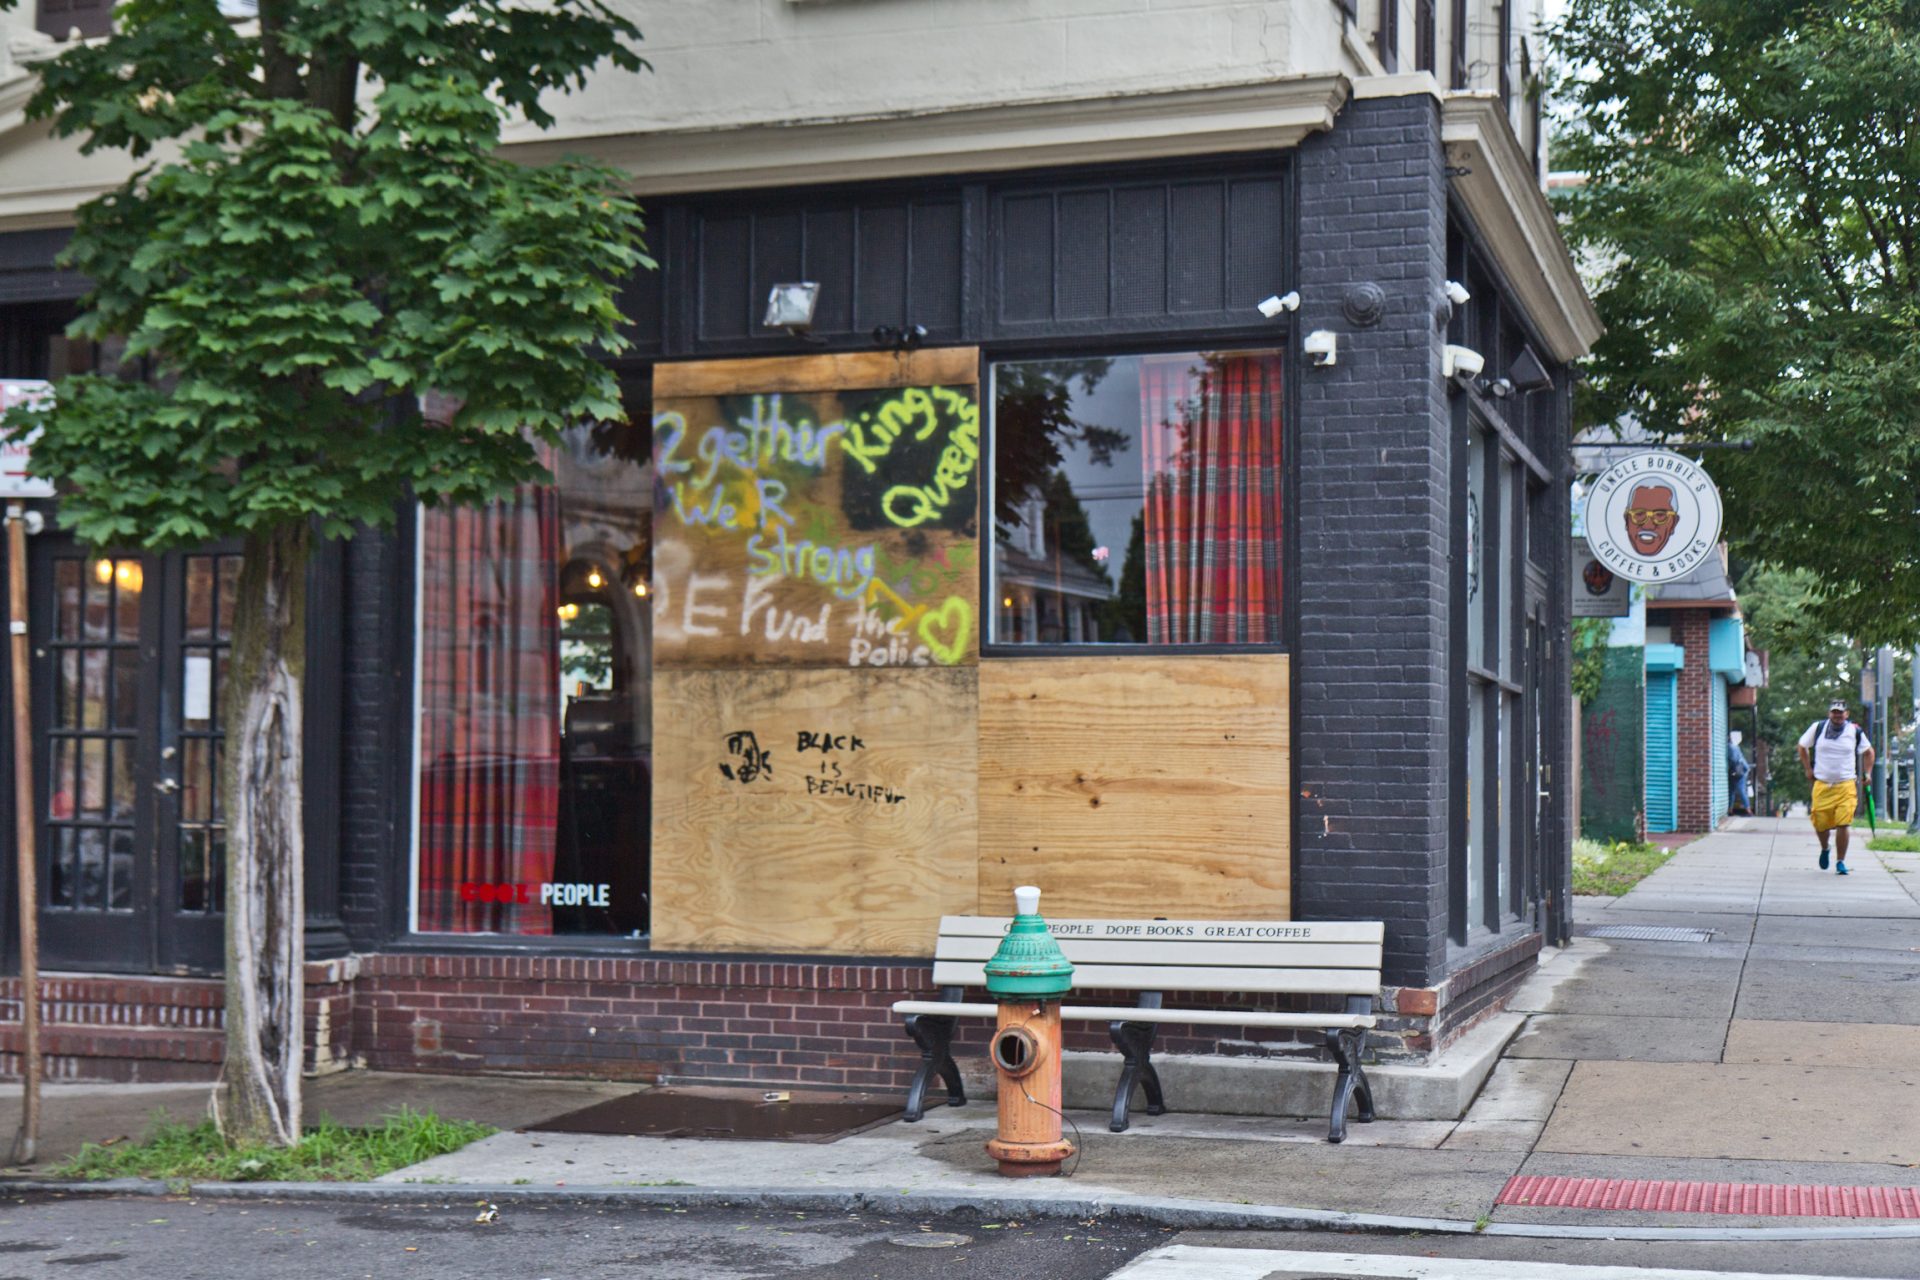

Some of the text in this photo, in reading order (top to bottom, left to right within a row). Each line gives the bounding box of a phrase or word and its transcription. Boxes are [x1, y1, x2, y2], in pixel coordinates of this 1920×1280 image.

[1601, 457, 1706, 492] UNCLE BOBBIE'S
[667, 479, 795, 531] We R
[747, 524, 874, 598] Strong
[1599, 540, 1706, 577] COFFEE & BOOKS
[797, 731, 866, 753] BLACK
[820, 760, 842, 778] IS
[540, 882, 611, 907] PEOPLE
[1105, 925, 1142, 935] DOPE
[1146, 925, 1194, 936] BOOKS
[1204, 926, 1253, 937] GREAT
[1256, 927, 1312, 938] COFFEE
